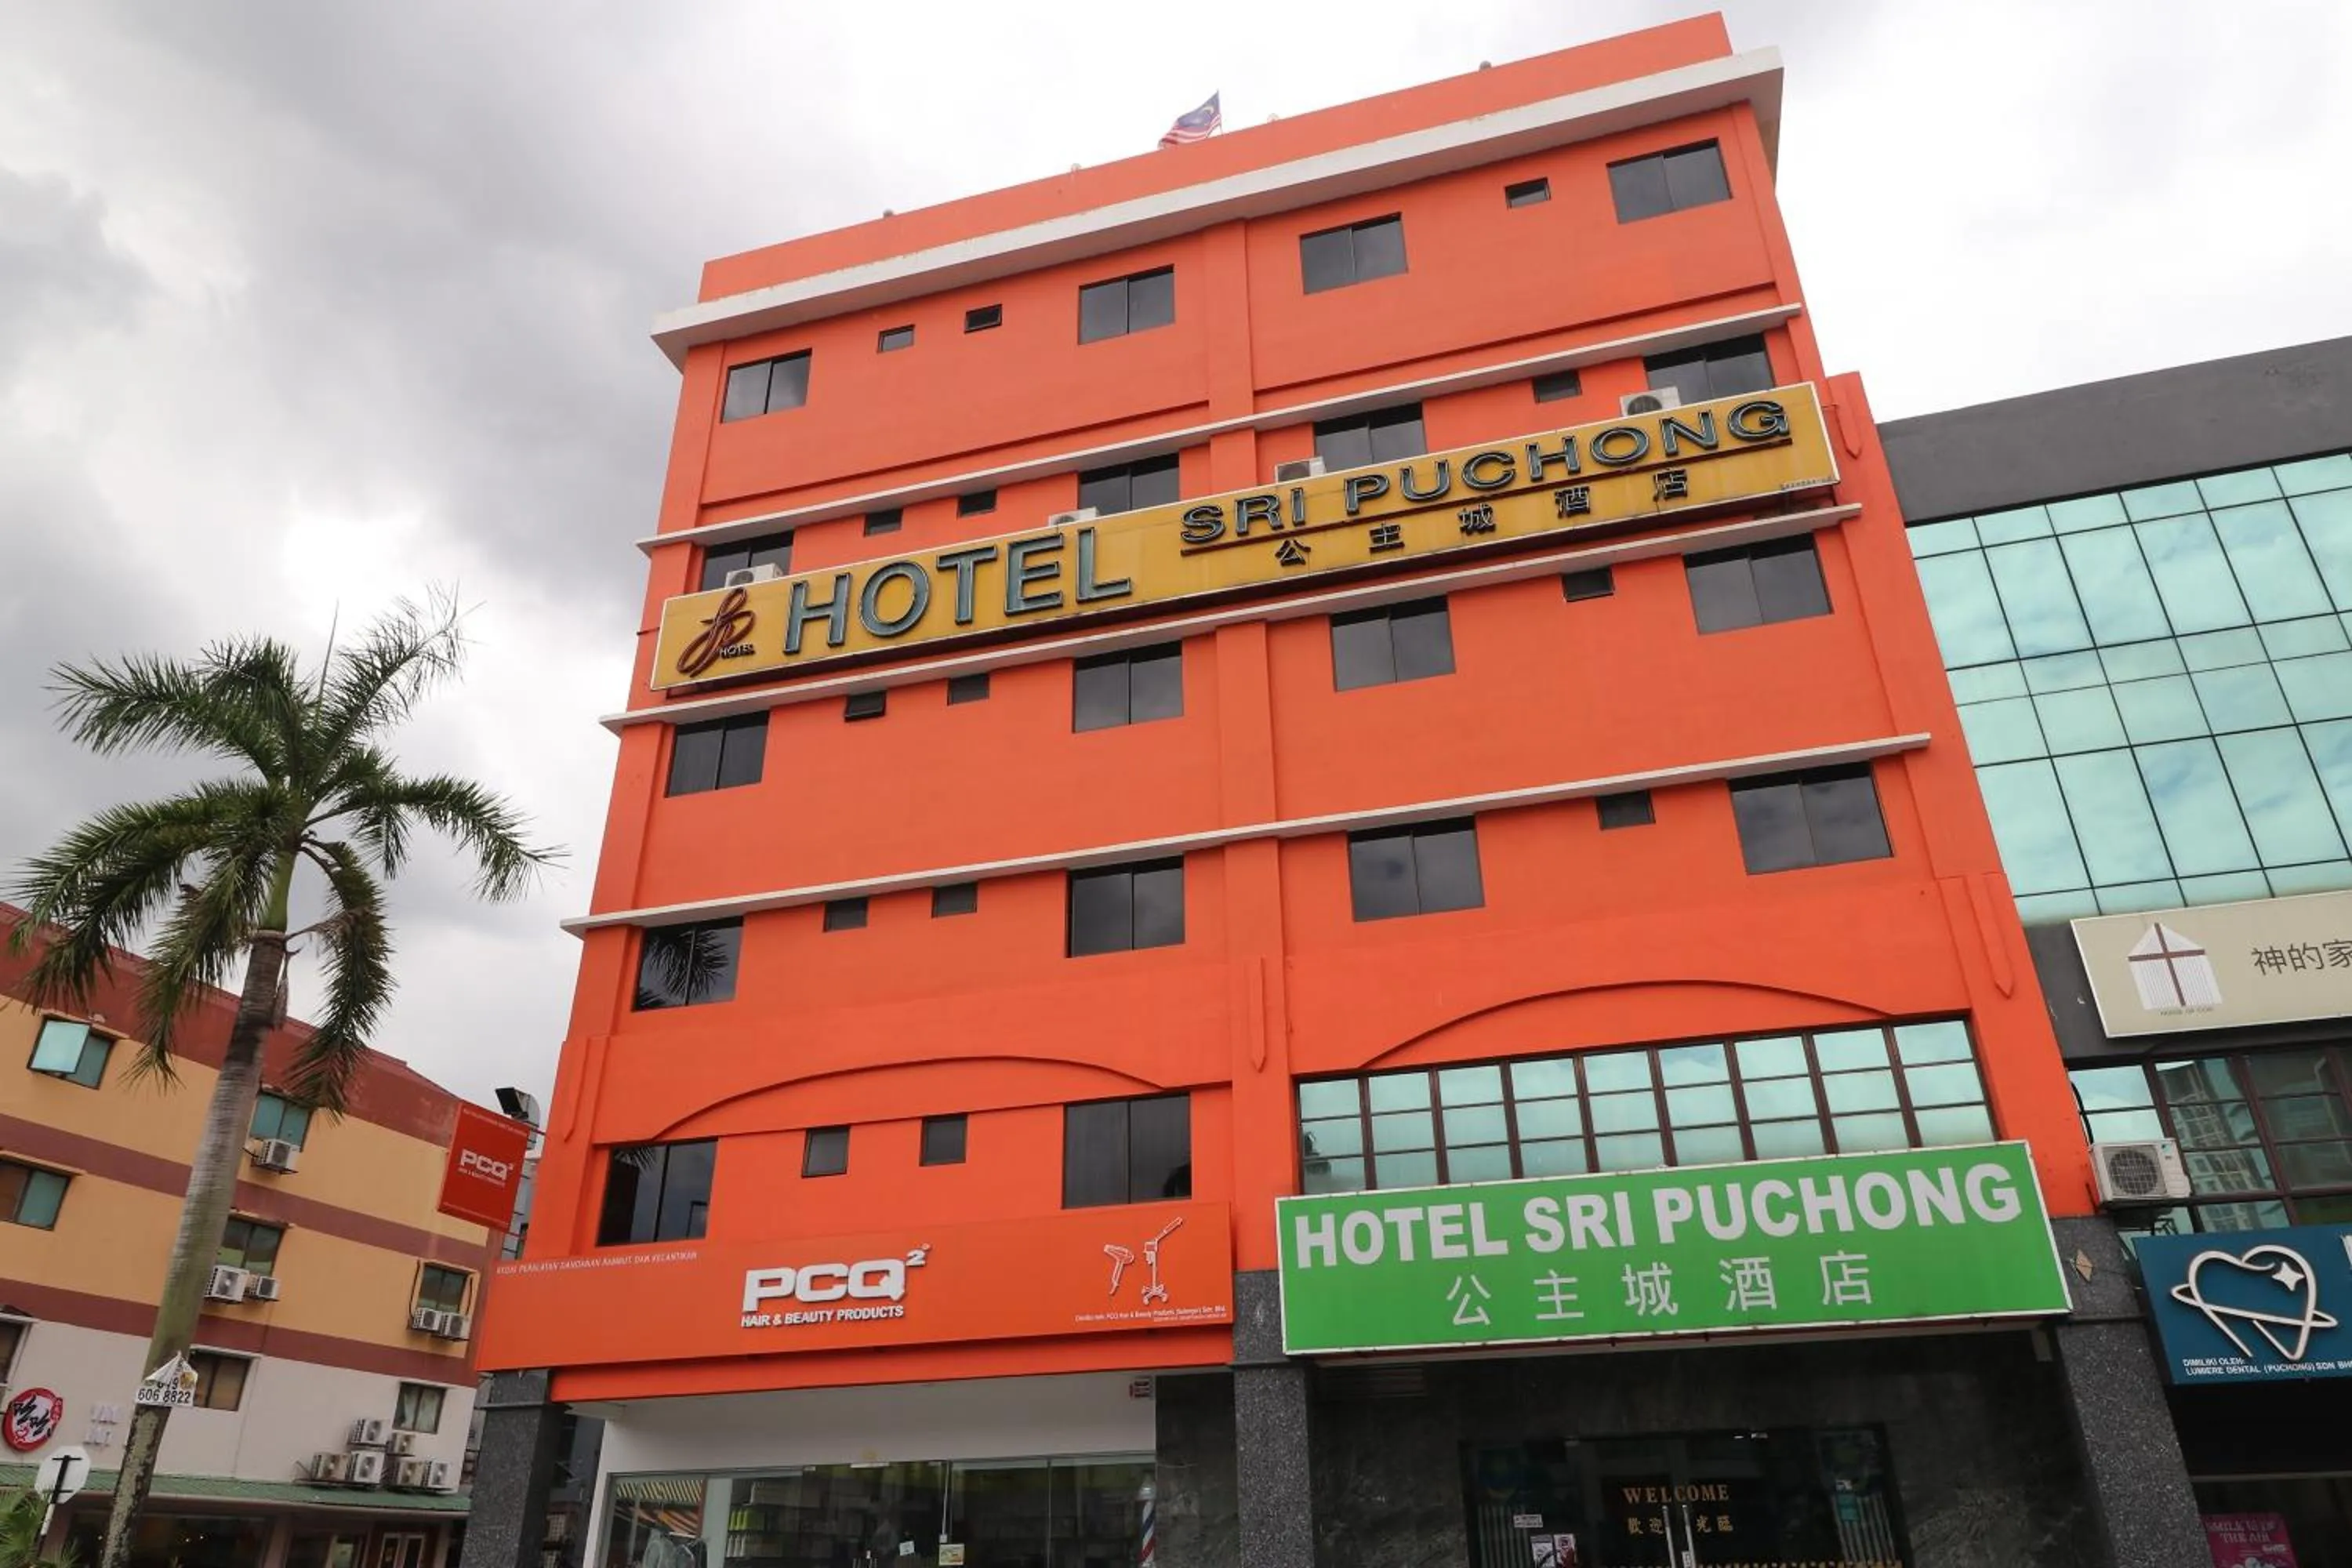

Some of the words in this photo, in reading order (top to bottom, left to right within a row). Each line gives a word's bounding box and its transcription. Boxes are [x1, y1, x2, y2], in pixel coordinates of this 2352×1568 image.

[783, 526, 1132, 655] HOTEL
[1181, 487, 1305, 544] SRI
[1345, 400, 1791, 514] PUCHONG
[1275, 468, 1687, 566] 公主城酒店
[719, 643, 756, 659] HOTEL
[2251, 939, 2352, 976] 神的家
[1294, 1202, 1509, 1269] HOTEL
[1523, 1190, 1636, 1253] SRI
[1652, 1163, 2022, 1244] PUCHONG
[1446, 1250, 1873, 1327] 公主城酒店
[741, 1314, 771, 1328] HAIR
[772, 1313, 782, 1326] &
[784, 1310, 833, 1325] BEAUTY
[837, 1305, 905, 1322] PRODUCTS
[2227, 1366, 2261, 1374] DENTAL
[137, 1388, 160, 1401] 606
[163, 1390, 191, 1403] 8822
[1622, 1484, 1730, 1504] WELCOME
